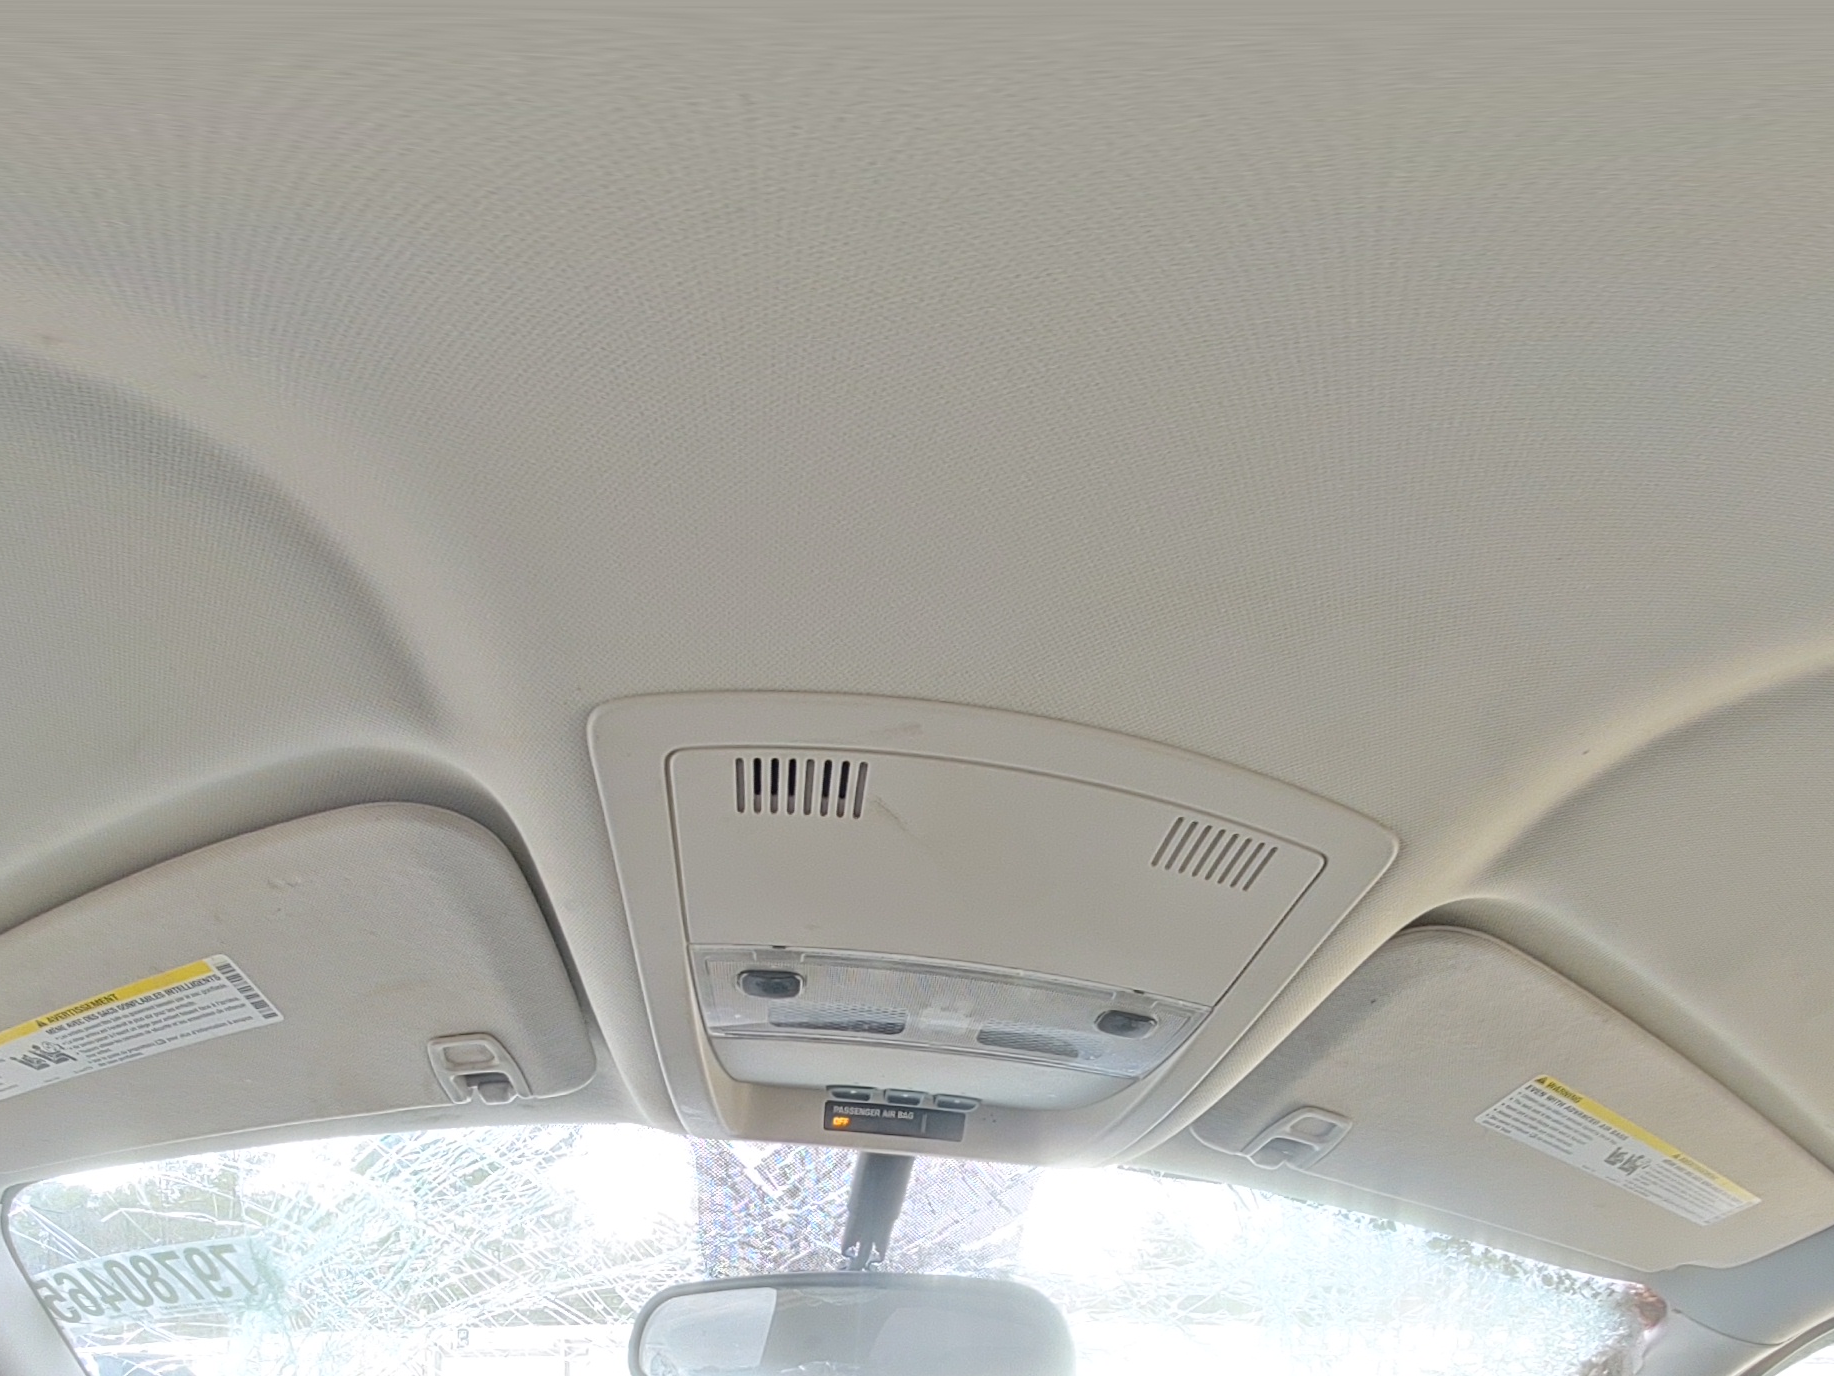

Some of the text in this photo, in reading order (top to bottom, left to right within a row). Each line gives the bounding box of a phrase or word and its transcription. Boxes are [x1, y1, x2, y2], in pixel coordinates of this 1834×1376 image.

[46, 993, 119, 1023] AVERTISSEMENT
[1546, 1081, 1584, 1104] WARNING
[833, 1105, 914, 1120] PASSENGER AIR BAG
[833, 1117, 850, 1126] OFF
